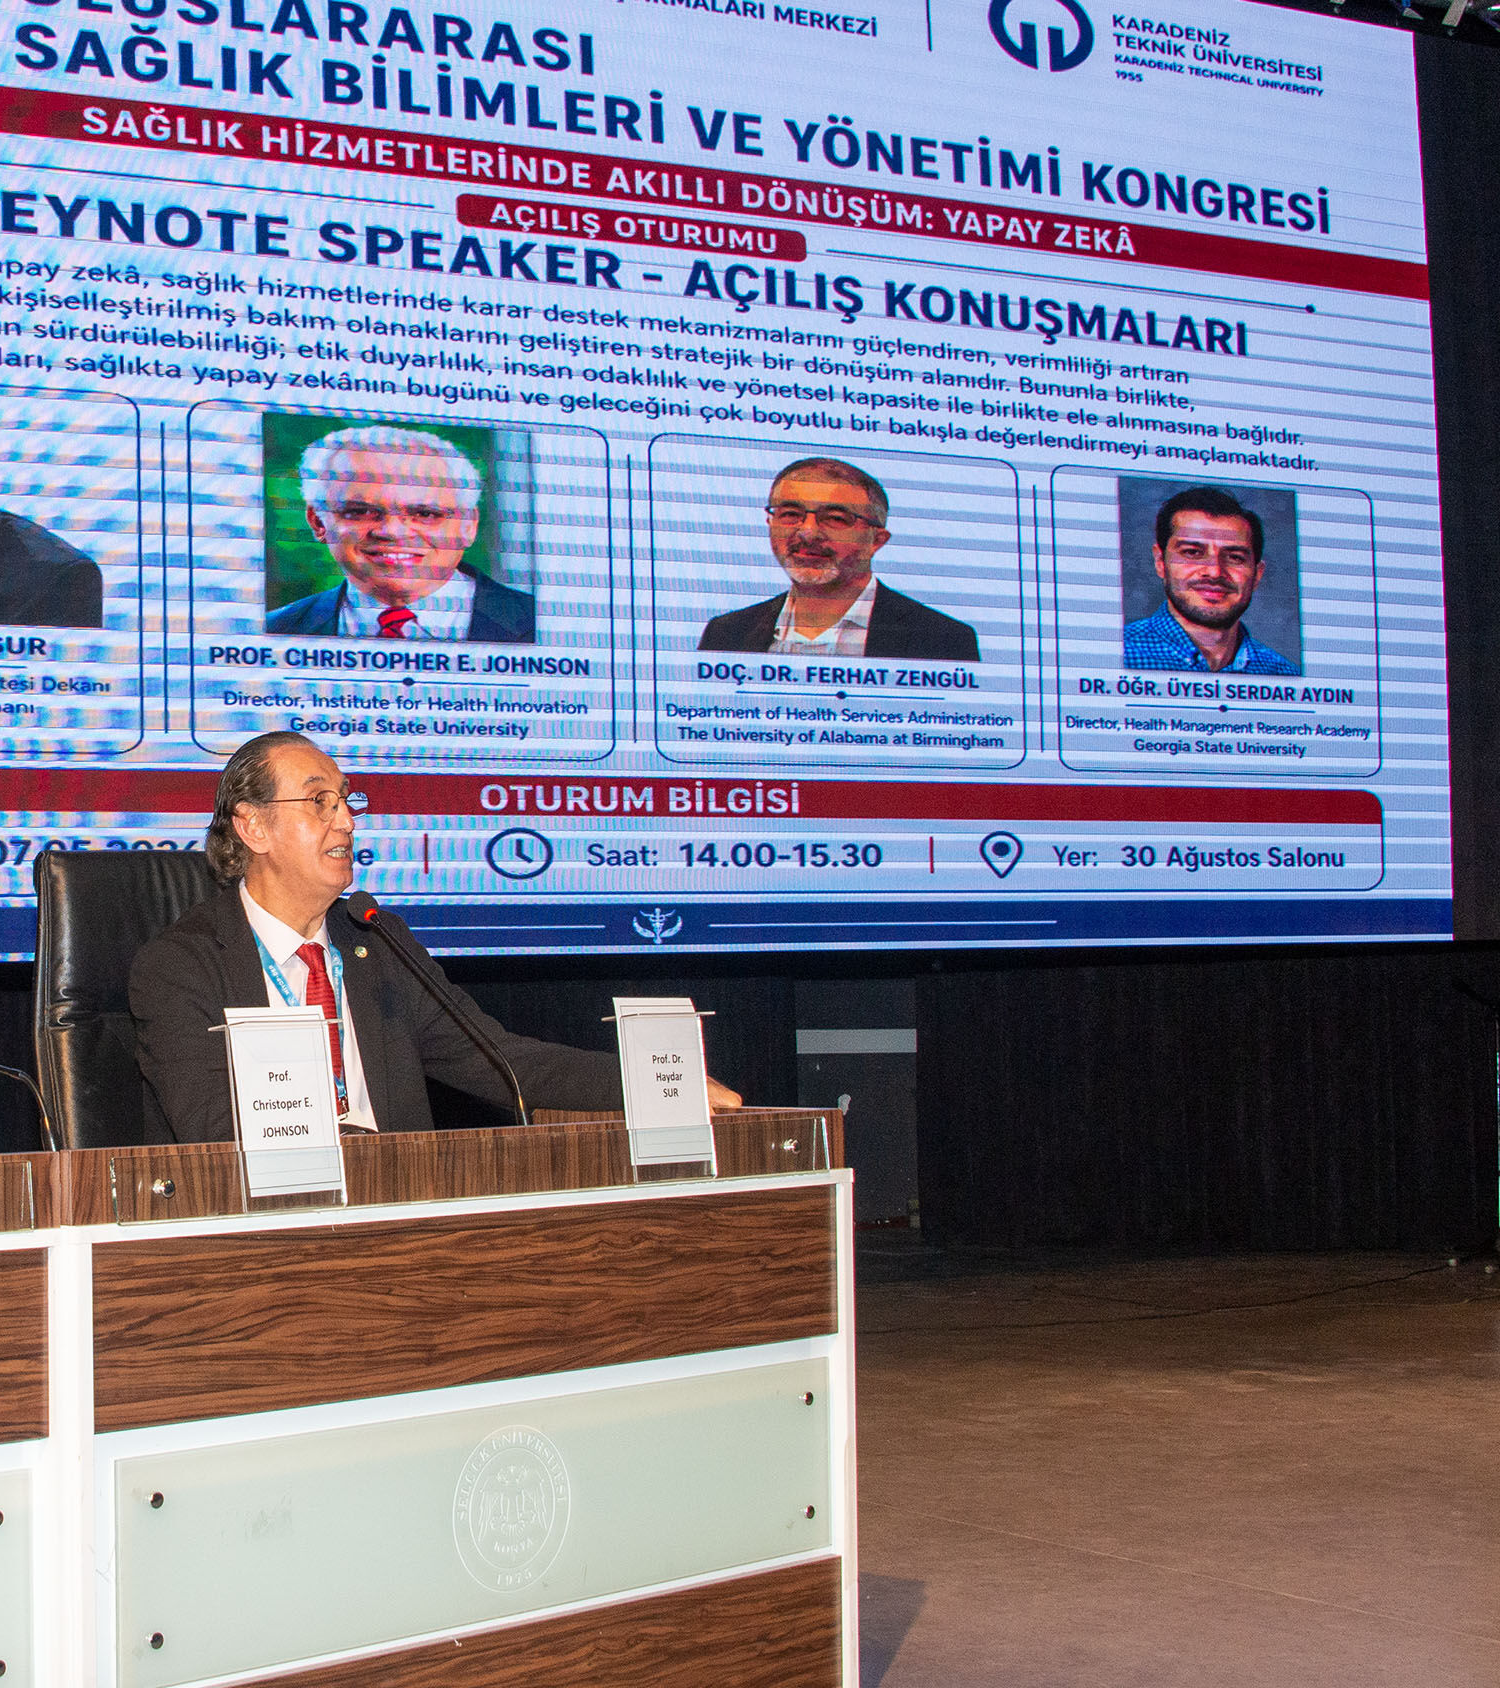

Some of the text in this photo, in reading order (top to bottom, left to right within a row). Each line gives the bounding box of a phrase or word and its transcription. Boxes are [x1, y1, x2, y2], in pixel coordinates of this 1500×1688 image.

[773, 4, 879, 38] MERKEZİ
[1112, 13, 1231, 47] KARADENİZ
[1112, 32, 1324, 82] TEKNİK ÜNİVERSİTESİ
[1115, 69, 1144, 83] 1955
[1187, 66, 1324, 97] TECHNICAL UNIVERSITY
[15, 24, 293, 99] SAĞLIK
[322, 54, 664, 145] BİLİMLERİ
[687, 107, 763, 157] VE
[783, 113, 1060, 197] YÖNETİMİ
[1082, 162, 1329, 235] KONGRESİ
[82, 106, 1136, 256] SAĞLIK HİZMETLERİNDE AKILLI DÖNÜŞÜM: YAPAY ZEKÂ
[488, 201, 776, 254] AÇILIŞ OTURUMU
[318, 222, 621, 290] SPEAKER
[683, 261, 863, 325] AÇILIŞ
[884, 281, 1247, 357] KONUŞMALARI
[71, 263, 149, 289] zekâ,
[161, 271, 246, 297] sağlık
[258, 277, 453, 313] hizmetlerinde
[463, 295, 533, 319] karar
[542, 304, 629, 329] destek
[639, 316, 843, 349] mekanizmalarını
[852, 338, 995, 367] güçlendiren,
[1004, 353, 1111, 381] verimliliği
[1119, 364, 1189, 385] artıran
[247, 305, 336, 331] bakım
[346, 316, 508, 346] olanaklarını
[518, 332, 641, 358] geliştiren
[650, 344, 753, 370] stratejik
[762, 351, 794, 371] bir
[803, 356, 913, 384] dönüşüm
[922, 368, 1010, 392] alanıdır.
[1019, 376, 1107, 402] Bununla
[1115, 386, 1194, 413] birlikte,
[33, 320, 285, 361] sürdürülebilirliği;
[297, 342, 350, 363] etik
[359, 346, 492, 382] duyarlılık,
[504, 356, 573, 380] insan
[581, 365, 688, 390] odaklılık
[697, 378, 726, 393] ve
[729, 381, 834, 402] yönetsel
[842, 386, 940, 413] kapasite
[947, 396, 973, 415] ile
[980, 399, 1059, 423] birlikte
[1066, 408, 1098, 426] ele
[1105, 412, 1218, 438] alınmasına
[1225, 422, 1304, 447] bağlıdır.
[65, 354, 182, 380] sağlıkta
[192, 366, 278, 391] yapay
[289, 370, 397, 395] zekânın
[407, 377, 511, 405] bugünü
[519, 391, 550, 407] ve
[559, 392, 690, 420] geleceğini
[699, 403, 743, 424] çok
[752, 405, 842, 431] boyutlu
[850, 414, 880, 433] bir
[888, 417, 967, 443] bakışla
[974, 425, 1148, 460] değerlendirmeyi
[1154, 443, 1319, 472] amaçlamaktadır.
[209, 646, 591, 677] PROF. CHRISTOPHER E. JOHNSON
[41, 677, 111, 693] Dekanı
[697, 662, 980, 689] DOÇ. DR. FERHAT ZENGÜL
[1079, 676, 1354, 704] DR. ÖĞR. ÜYESİ SERDAR AYDIN
[312, 693, 390, 711] Institute
[395, 695, 423, 712] for
[427, 696, 488, 713] Health
[494, 698, 589, 715] Innovation
[665, 702, 1014, 728] Department Health Services Administration
[289, 716, 529, 740] Georgia State University
[677, 726, 1005, 750] The University Alabama at Birmingham
[1065, 714, 1371, 741] Director, Health Management Research Academy
[1133, 738, 1307, 759] Georgia State University
[479, 780, 801, 815] OTURUM BİLGİSİ
[586, 842, 883, 868] Saat: 14.00-15.30
[1052, 845, 1346, 872] Yer: 30 Ağustos Salonu
[651, 1053, 684, 1065] Prof. Dr.
[268, 1070, 292, 1083] Prof.
[655, 1071, 683, 1083] Haydar
[252, 1098, 303, 1112] Christoper
[662, 1088, 680, 1098] SUR
[262, 1124, 310, 1138] JOHNSON
